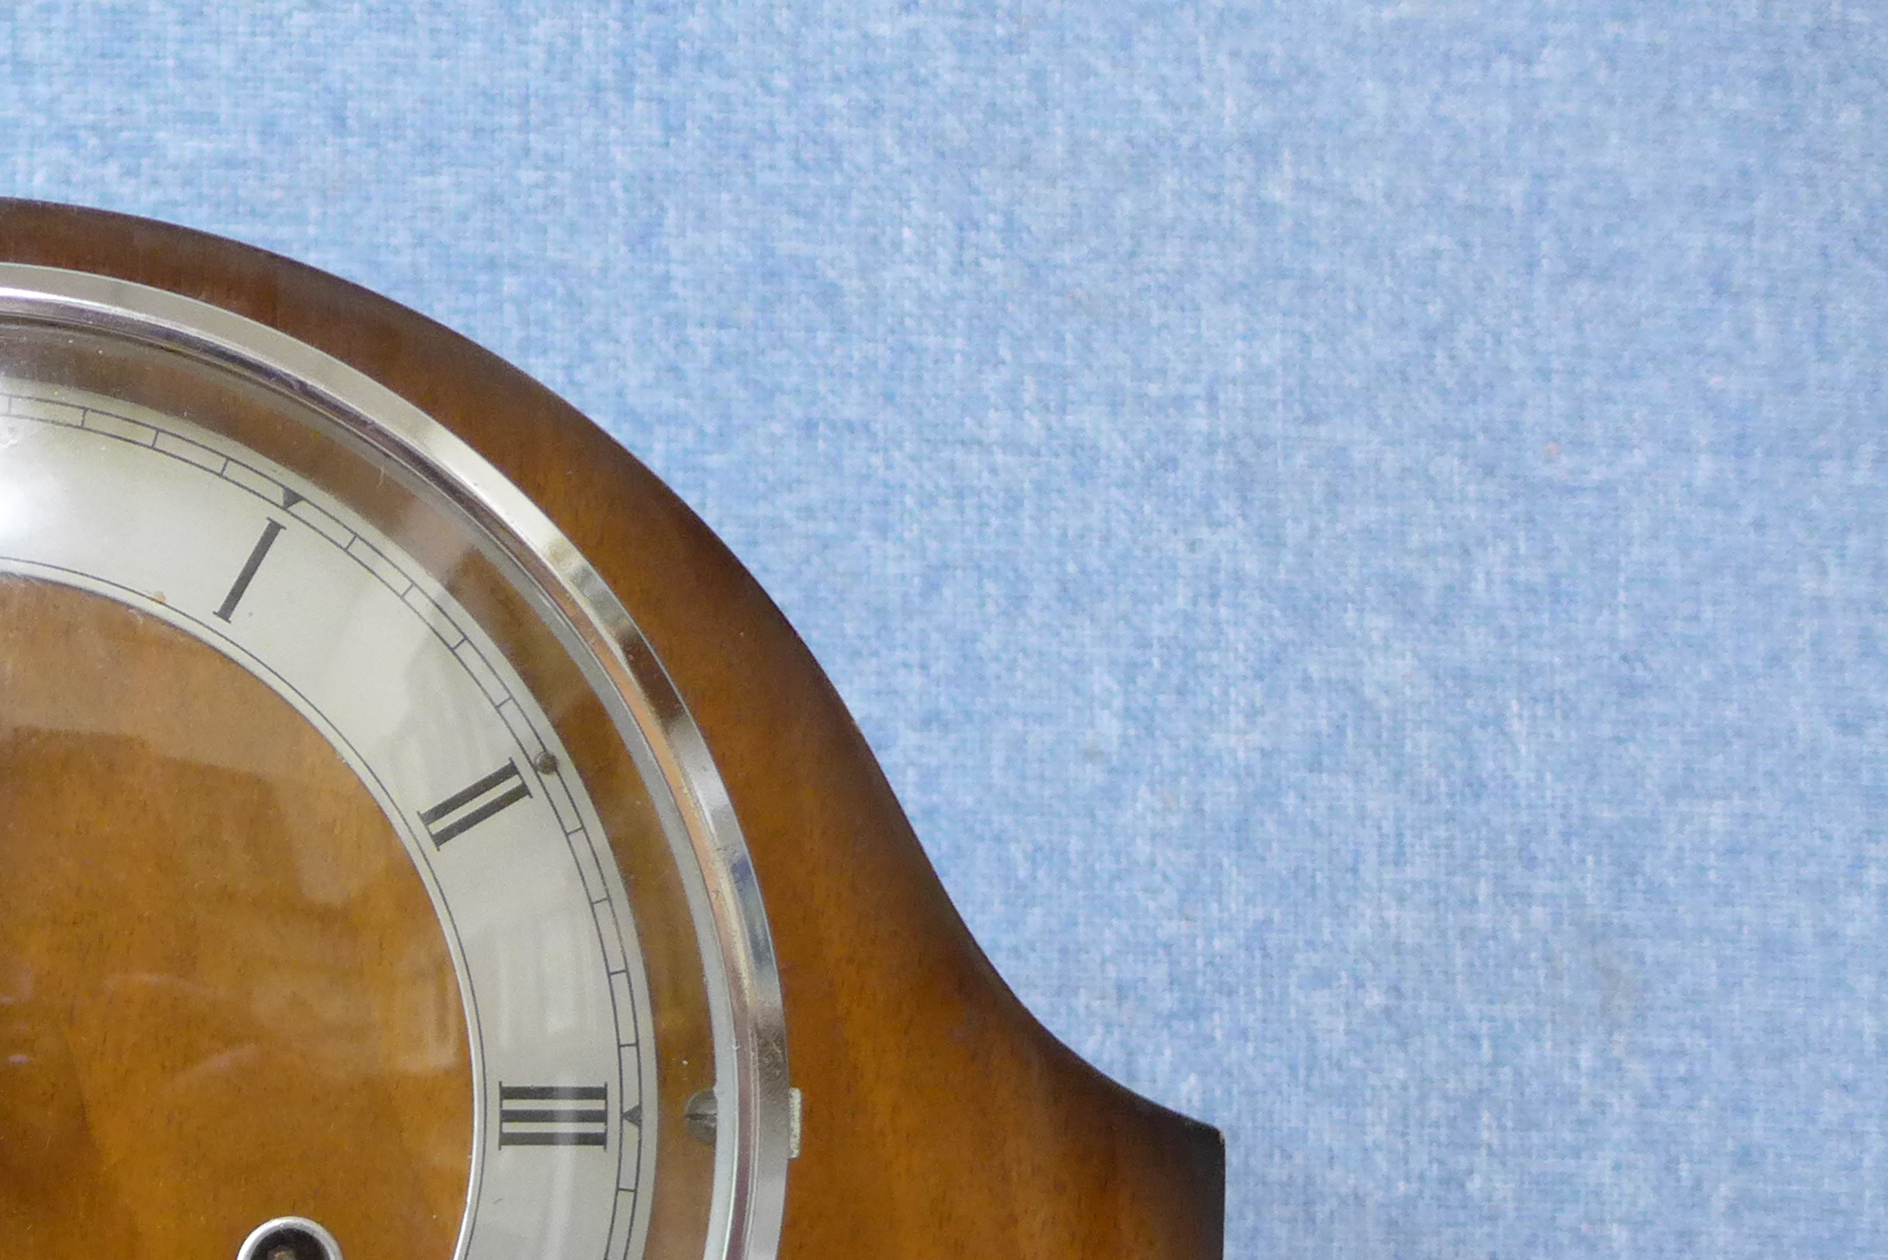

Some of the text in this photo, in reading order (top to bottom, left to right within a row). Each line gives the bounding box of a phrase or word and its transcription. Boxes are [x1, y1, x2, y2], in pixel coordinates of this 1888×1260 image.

[213, 517, 287, 624] I
[416, 757, 534, 852] II
[499, 1081, 608, 1152] III
